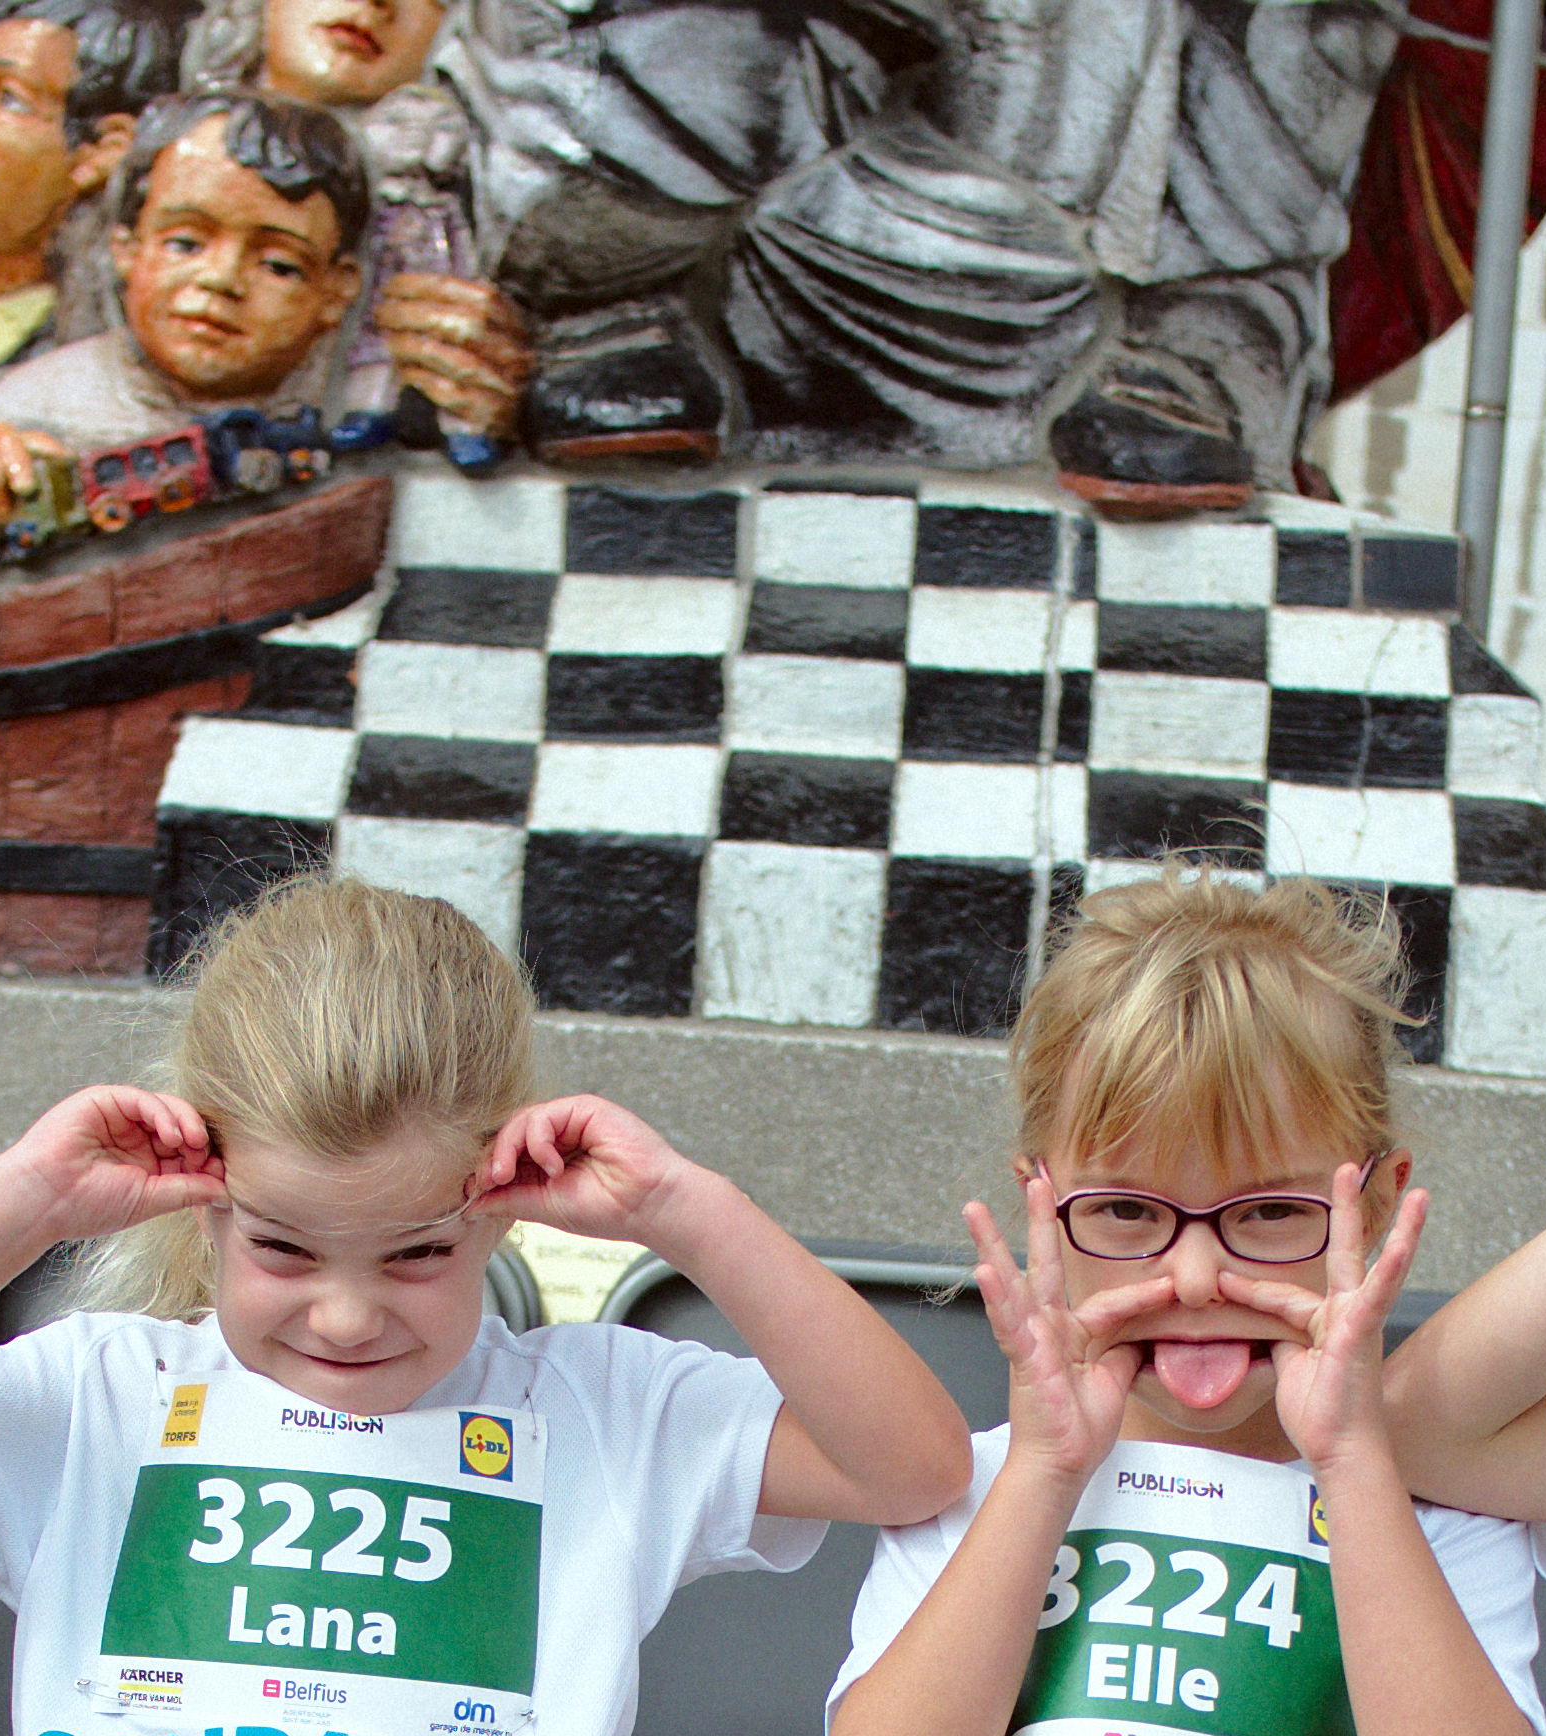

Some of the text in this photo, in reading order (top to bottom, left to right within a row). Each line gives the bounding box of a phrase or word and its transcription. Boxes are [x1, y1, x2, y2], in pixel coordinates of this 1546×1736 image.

[281, 1408, 383, 1434] PUBLISIGN
[165, 1431, 196, 1442] TORFS
[1118, 1471, 1223, 1499] PUBLISIGN
[188, 1477, 452, 1582] 3225
[1037, 1541, 1302, 1649] 3224
[227, 1585, 398, 1656] Lana
[1086, 1642, 1220, 1712] Elle
[284, 1680, 347, 1704] Belfius
[454, 1697, 495, 1723] dm
